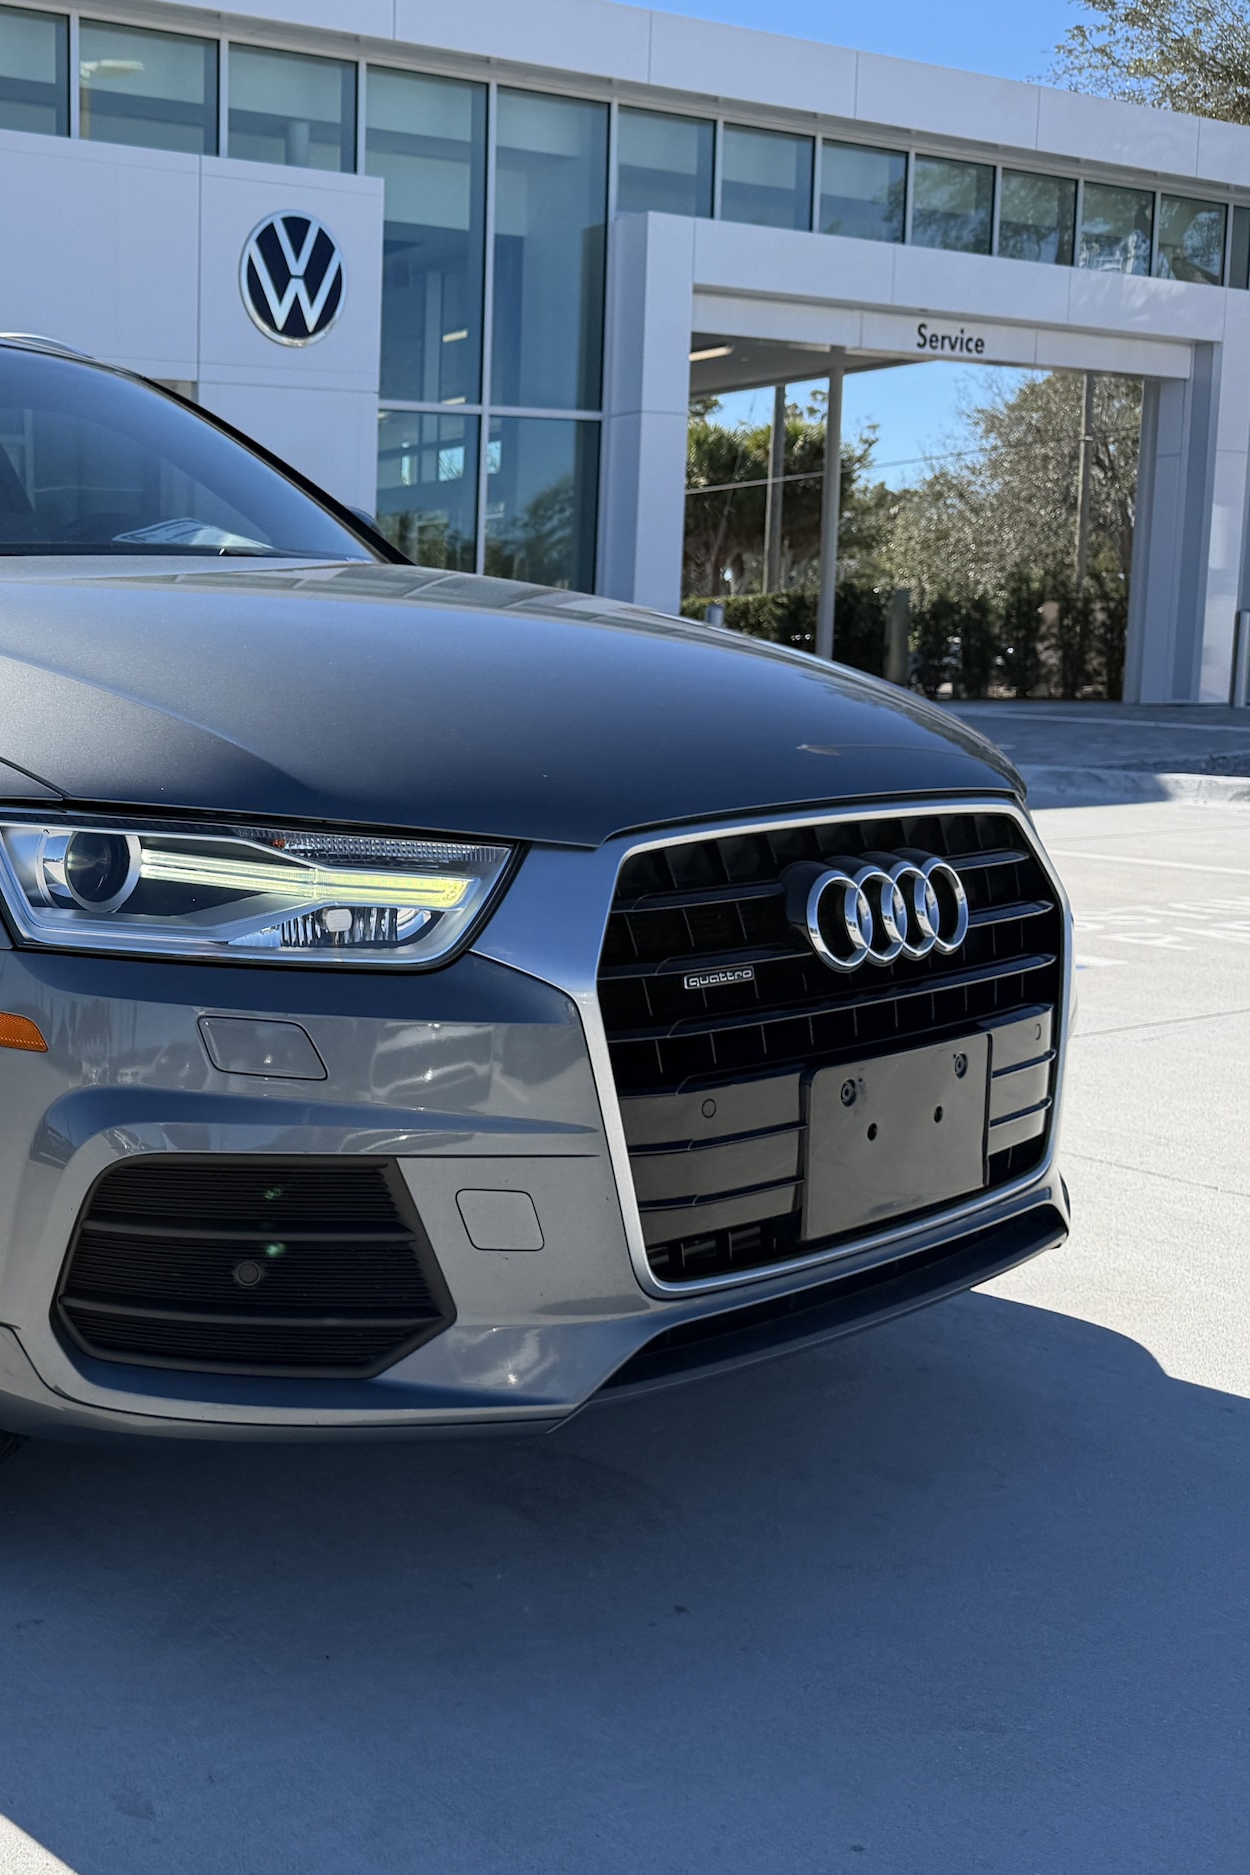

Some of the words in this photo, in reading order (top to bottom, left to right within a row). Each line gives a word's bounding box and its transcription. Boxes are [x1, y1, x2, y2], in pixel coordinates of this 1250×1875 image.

[249, 215, 343, 334] VW
[916, 323, 985, 354] Service
[688, 969, 752, 988] quattro
